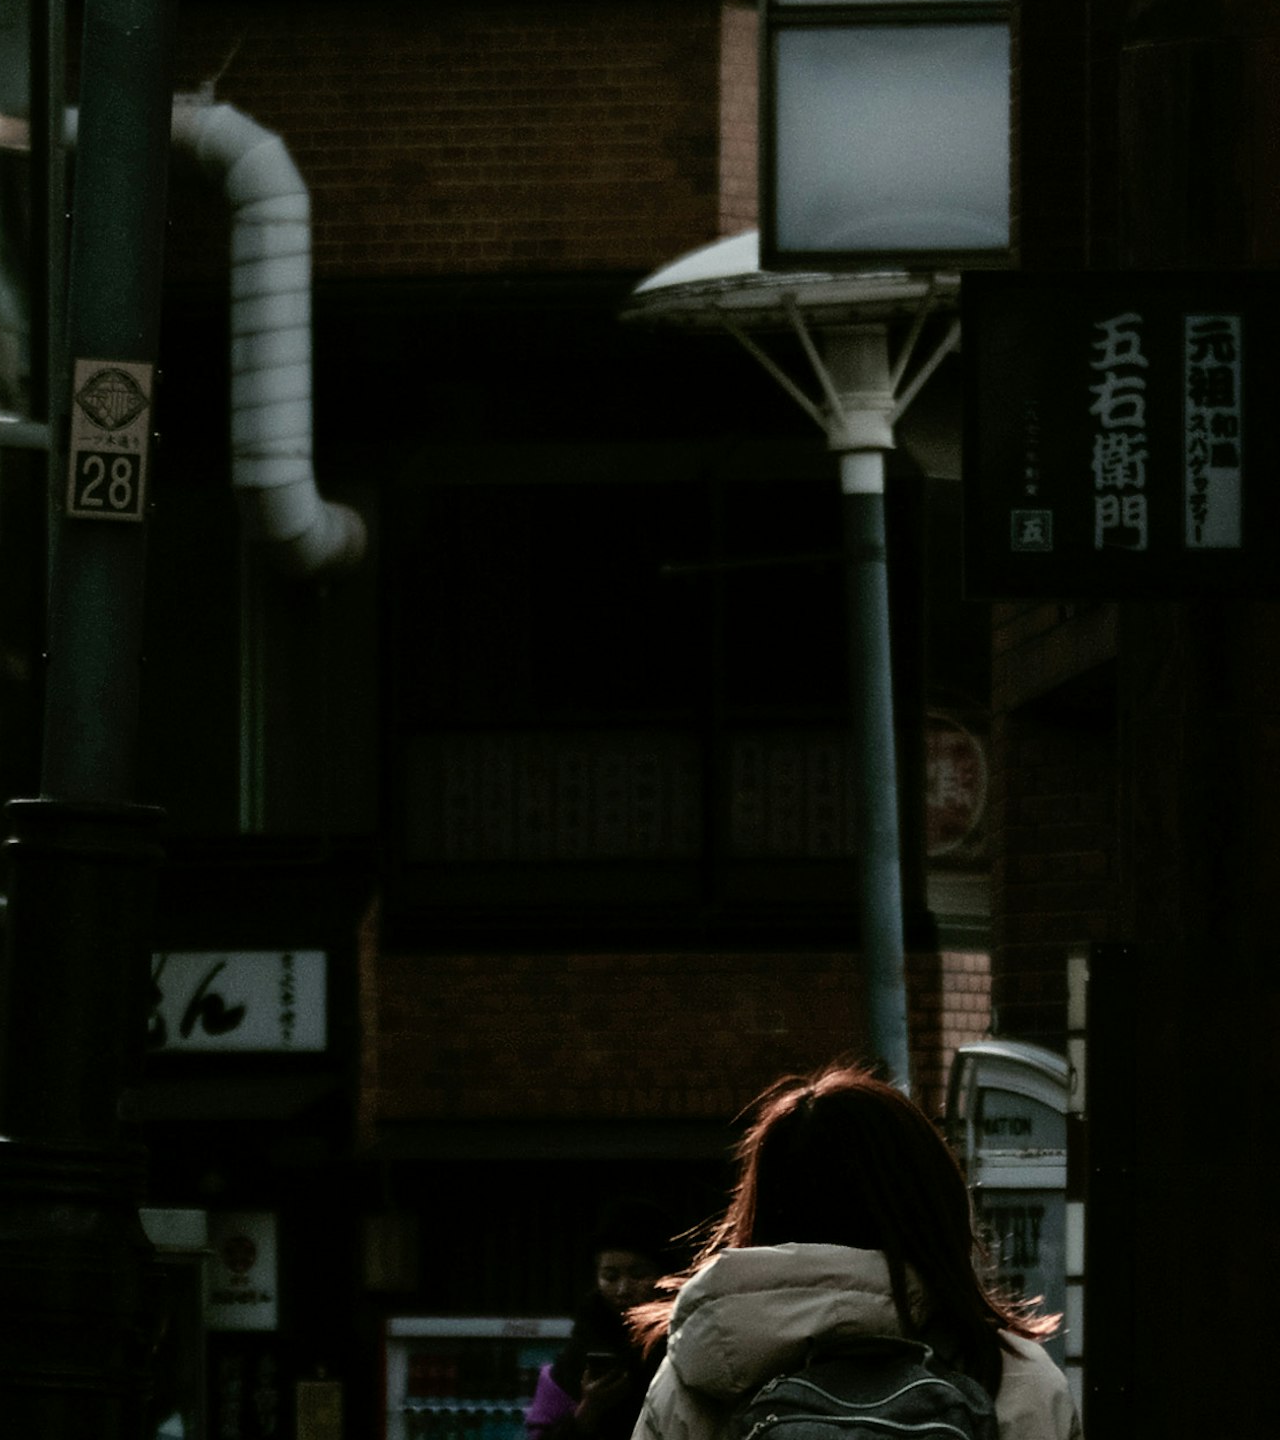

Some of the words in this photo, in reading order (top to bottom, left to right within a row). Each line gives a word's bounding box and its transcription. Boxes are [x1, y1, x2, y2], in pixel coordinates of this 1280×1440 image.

[80, 454, 133, 511] 28
[1088, 311, 1151, 552] 五右衛門
